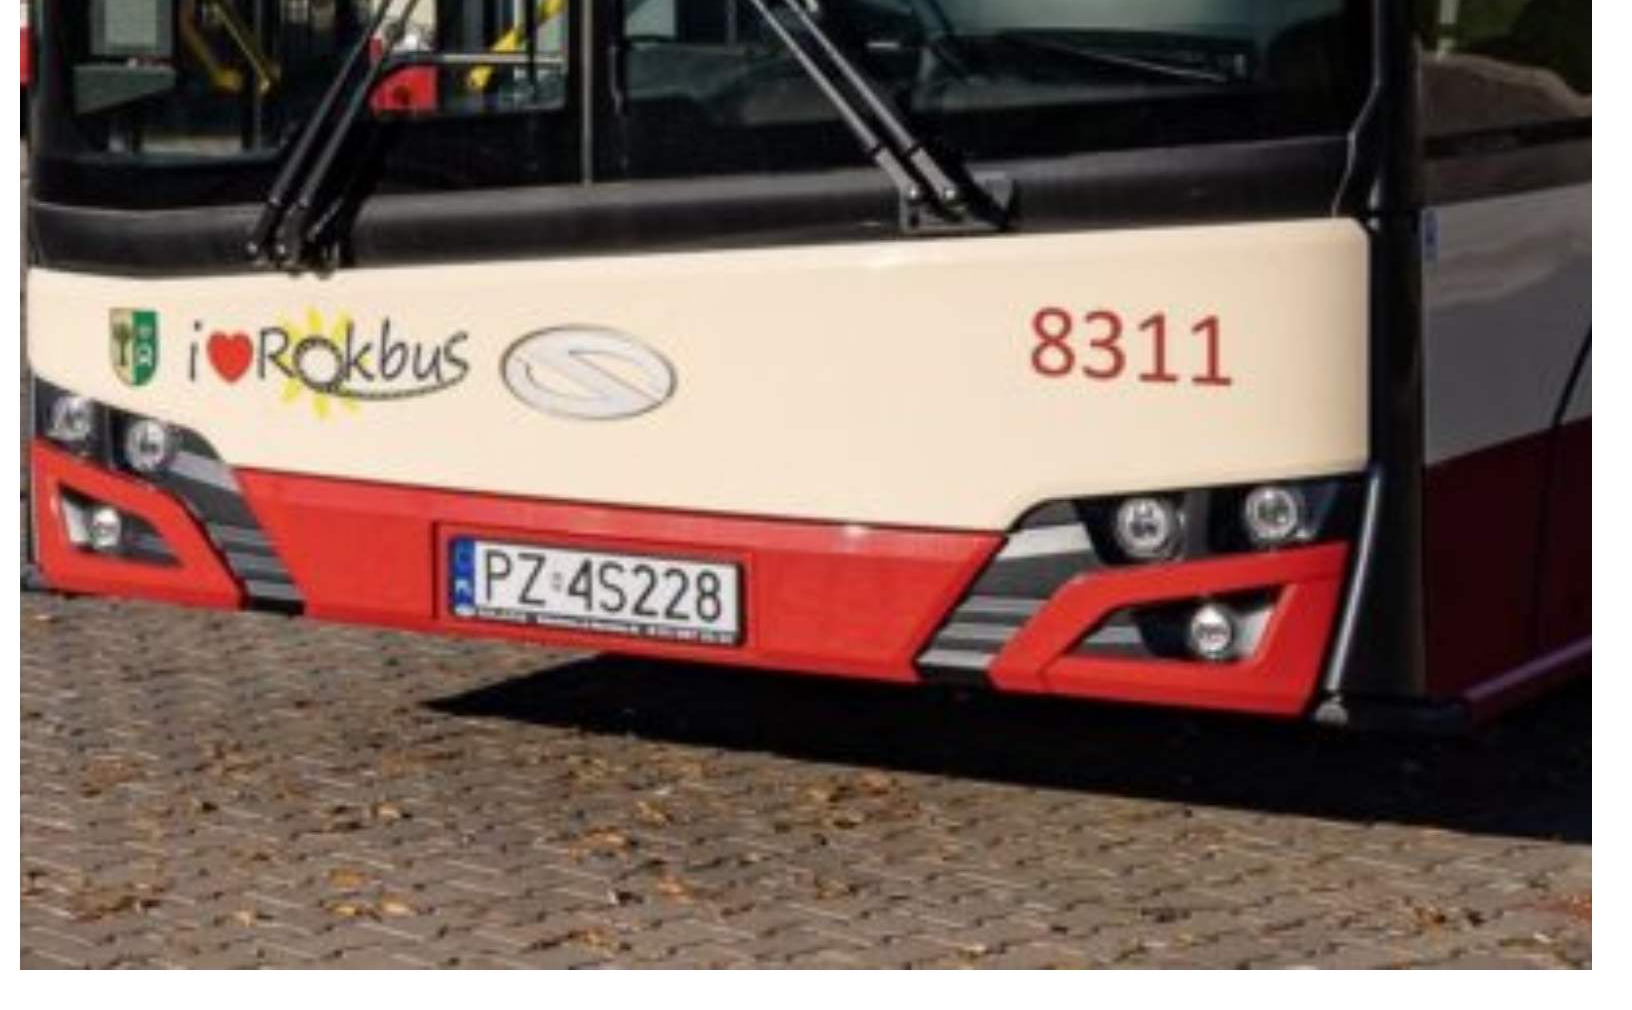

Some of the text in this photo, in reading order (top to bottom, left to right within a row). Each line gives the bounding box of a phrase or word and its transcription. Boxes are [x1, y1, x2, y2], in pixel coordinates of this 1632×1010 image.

[1030, 306, 1233, 387] 8311
[484, 549, 546, 606] PZ
[567, 558, 722, 623] 4S228
